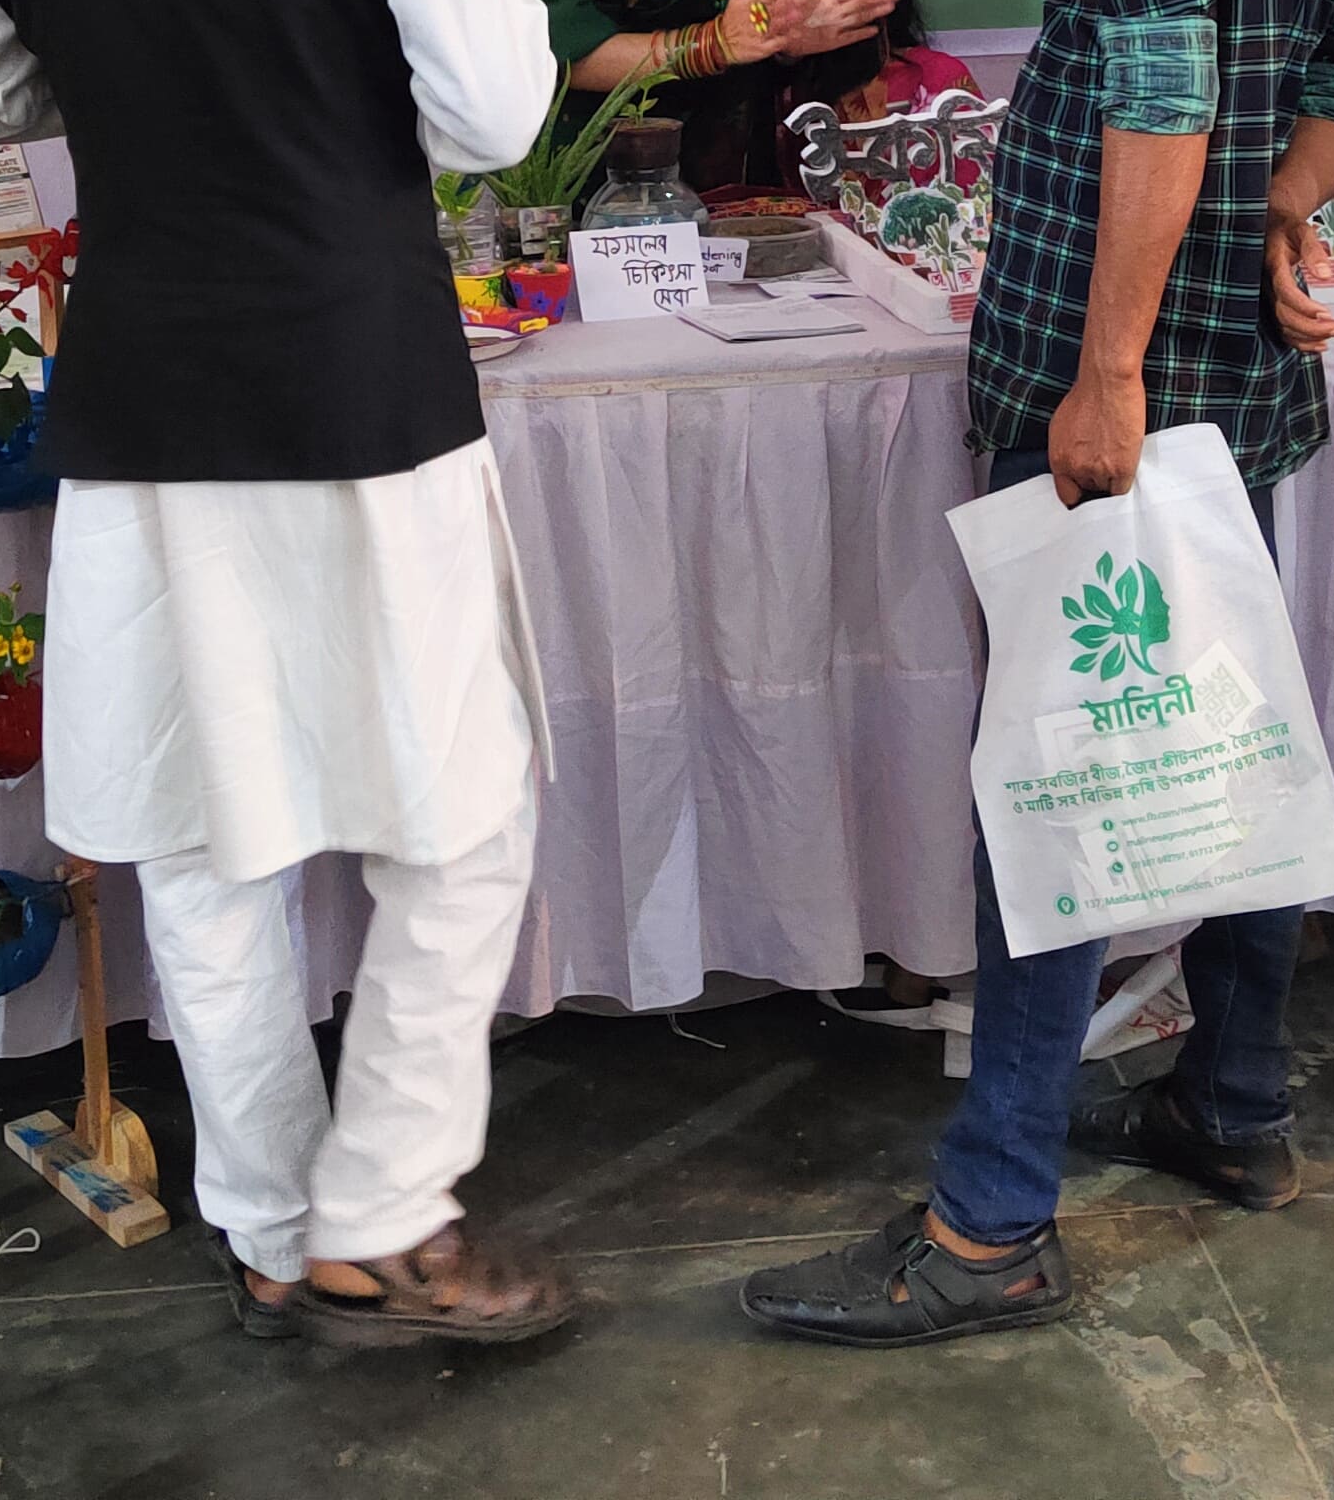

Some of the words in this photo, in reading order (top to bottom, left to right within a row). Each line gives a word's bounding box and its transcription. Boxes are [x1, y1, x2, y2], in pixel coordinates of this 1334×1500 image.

[653, 287, 699, 313] সেবা
[1077, 673, 1197, 734] মালিনী
[1126, 776, 1155, 800] কৃষি
